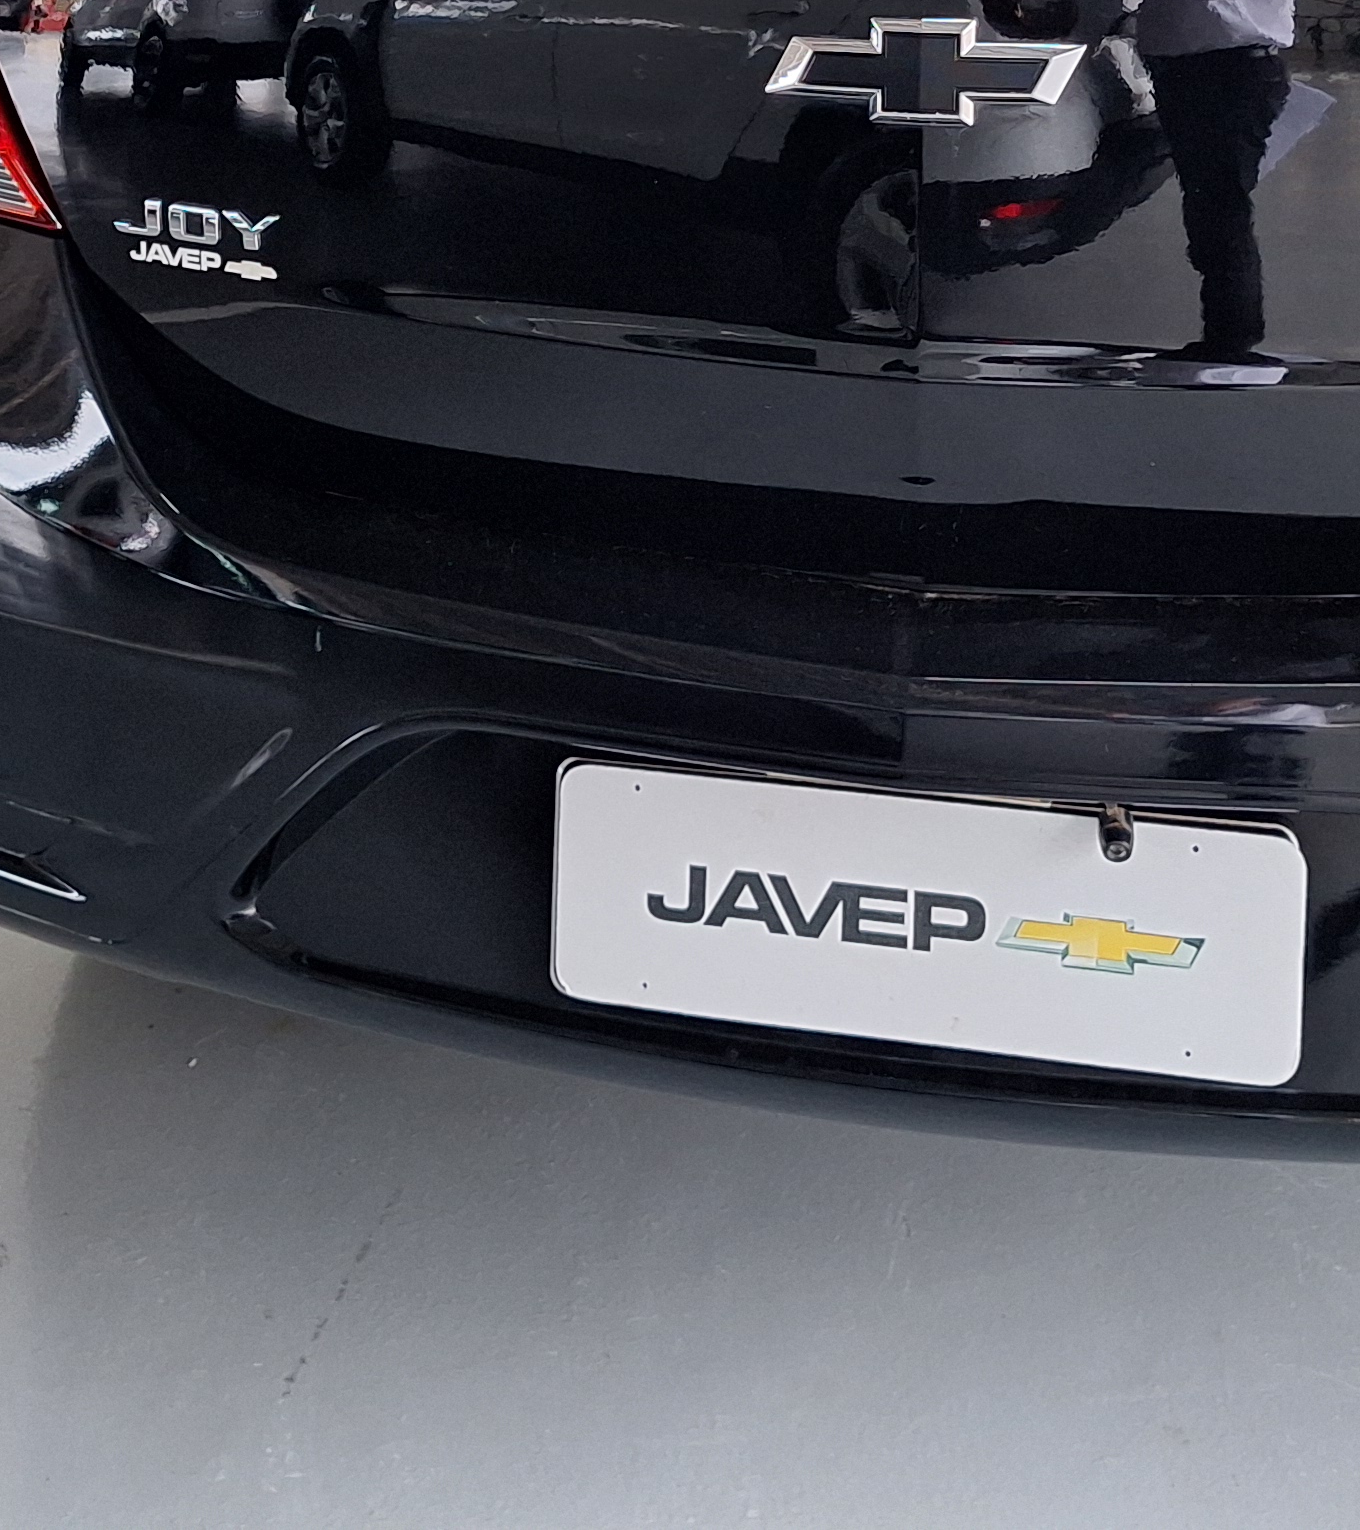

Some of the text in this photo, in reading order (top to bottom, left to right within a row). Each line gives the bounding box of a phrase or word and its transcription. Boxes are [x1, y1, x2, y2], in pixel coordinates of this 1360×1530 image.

[113, 197, 281, 250] JOY
[130, 240, 221, 271] JAVEP
[647, 864, 986, 951] JAVEP
